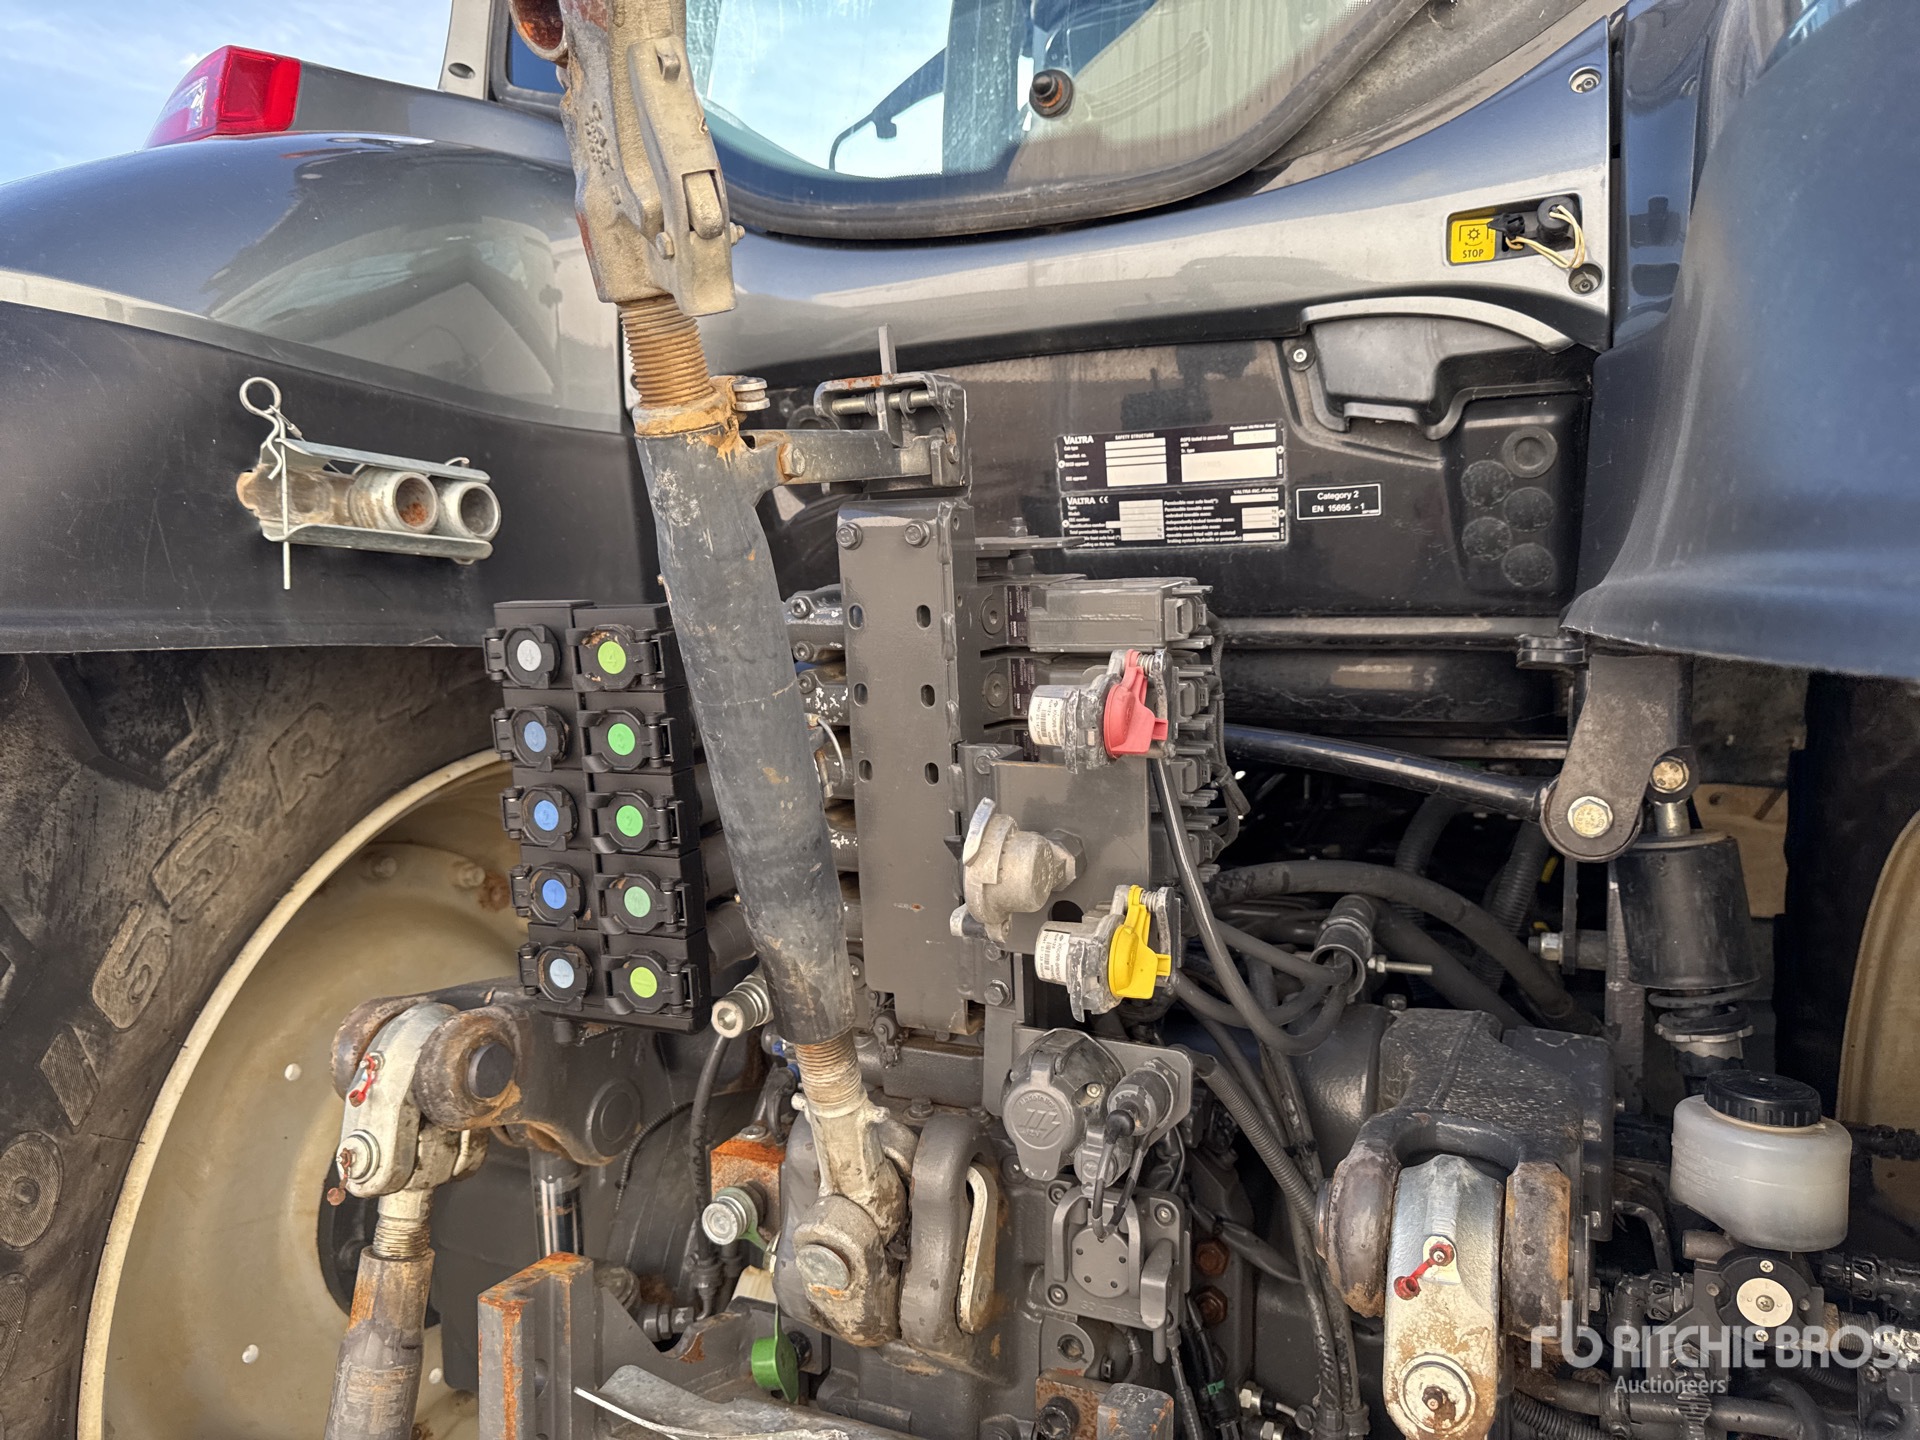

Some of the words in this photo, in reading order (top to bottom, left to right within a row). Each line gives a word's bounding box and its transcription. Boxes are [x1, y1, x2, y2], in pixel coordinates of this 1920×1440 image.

[1462, 249, 1484, 259] STOP
[1063, 435, 1094, 445] VALTRA
[1066, 496, 1096, 505] VALTRA
[1317, 492, 1352, 501] Category
[1353, 490, 1359, 498] 2
[1311, 504, 1324, 513] EN
[1327, 503, 1352, 512] 15695
[1360, 502, 1365, 510] 1
